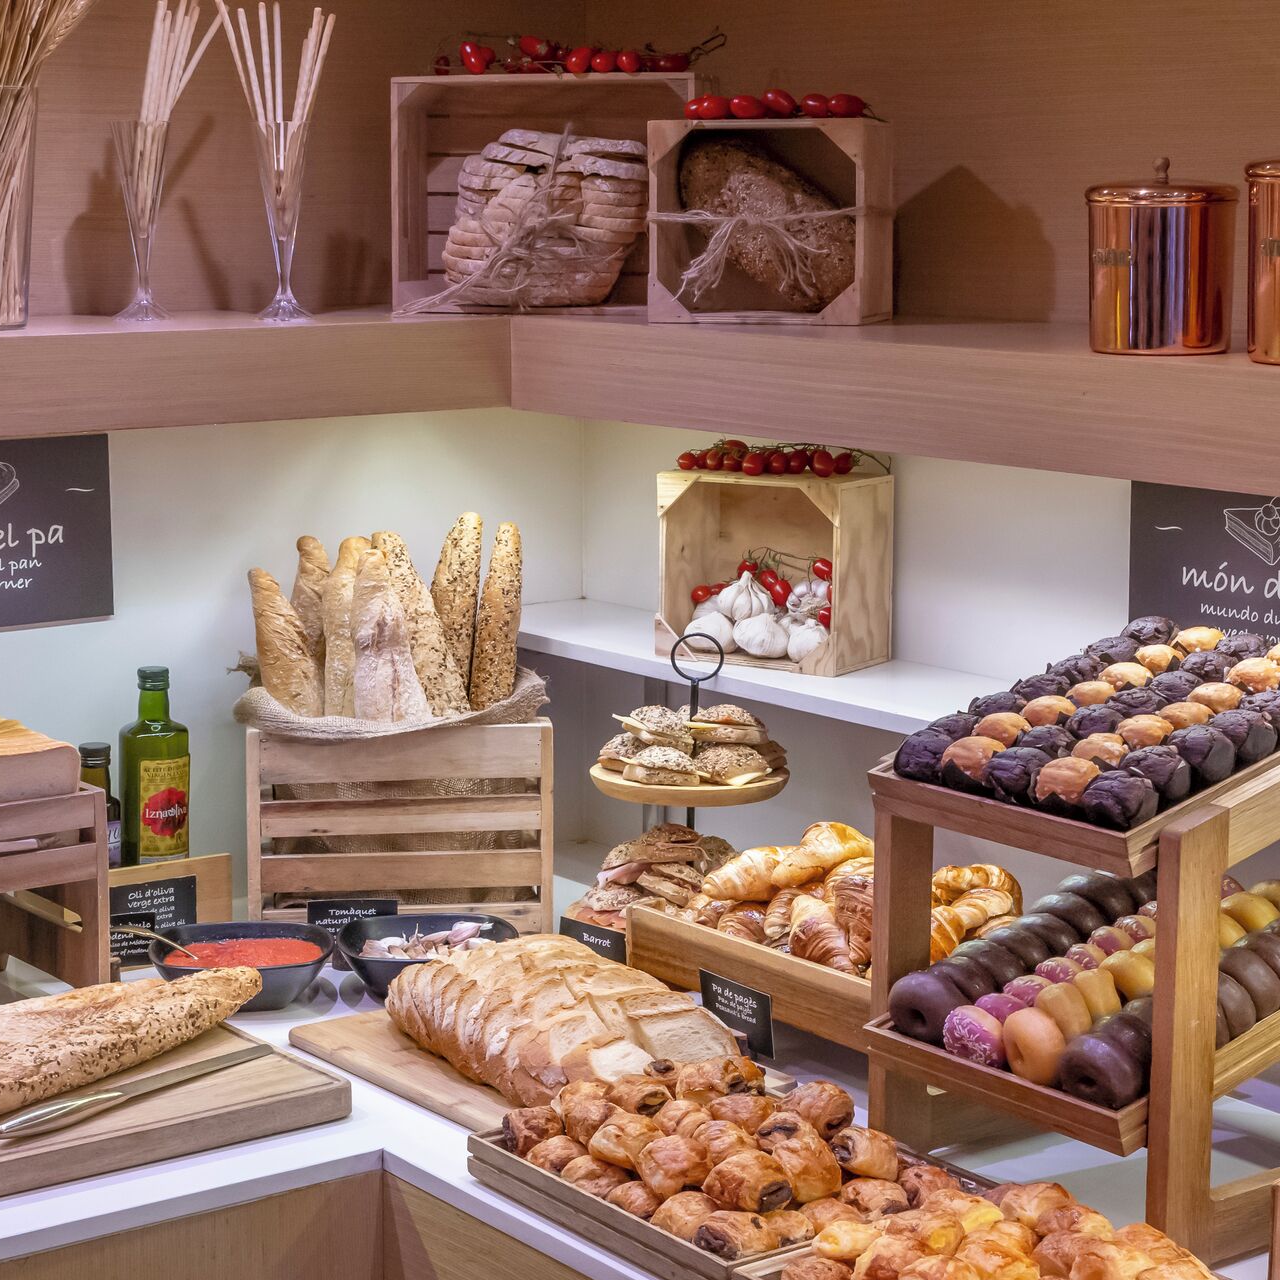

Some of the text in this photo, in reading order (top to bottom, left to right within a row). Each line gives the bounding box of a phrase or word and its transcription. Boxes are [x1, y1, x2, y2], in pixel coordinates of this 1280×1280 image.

[26, 523, 64, 558] pa
[9, 557, 42, 577] pan
[1181, 561, 1255, 595] món
[1200, 603, 1259, 623] mundo
[128, 887, 175, 900] Oli d'oliva
[127, 895, 175, 909] verge extra
[158, 905, 176, 913] oliva
[328, 906, 377, 918] Tomàquet
[156, 913, 173, 921] extra
[315, 916, 351, 926] natural
[160, 920, 176, 929] olive
[110, 931, 134, 940] dena
[582, 932, 612, 948] Barrot
[711, 982, 758, 1009] Pa de pagès
